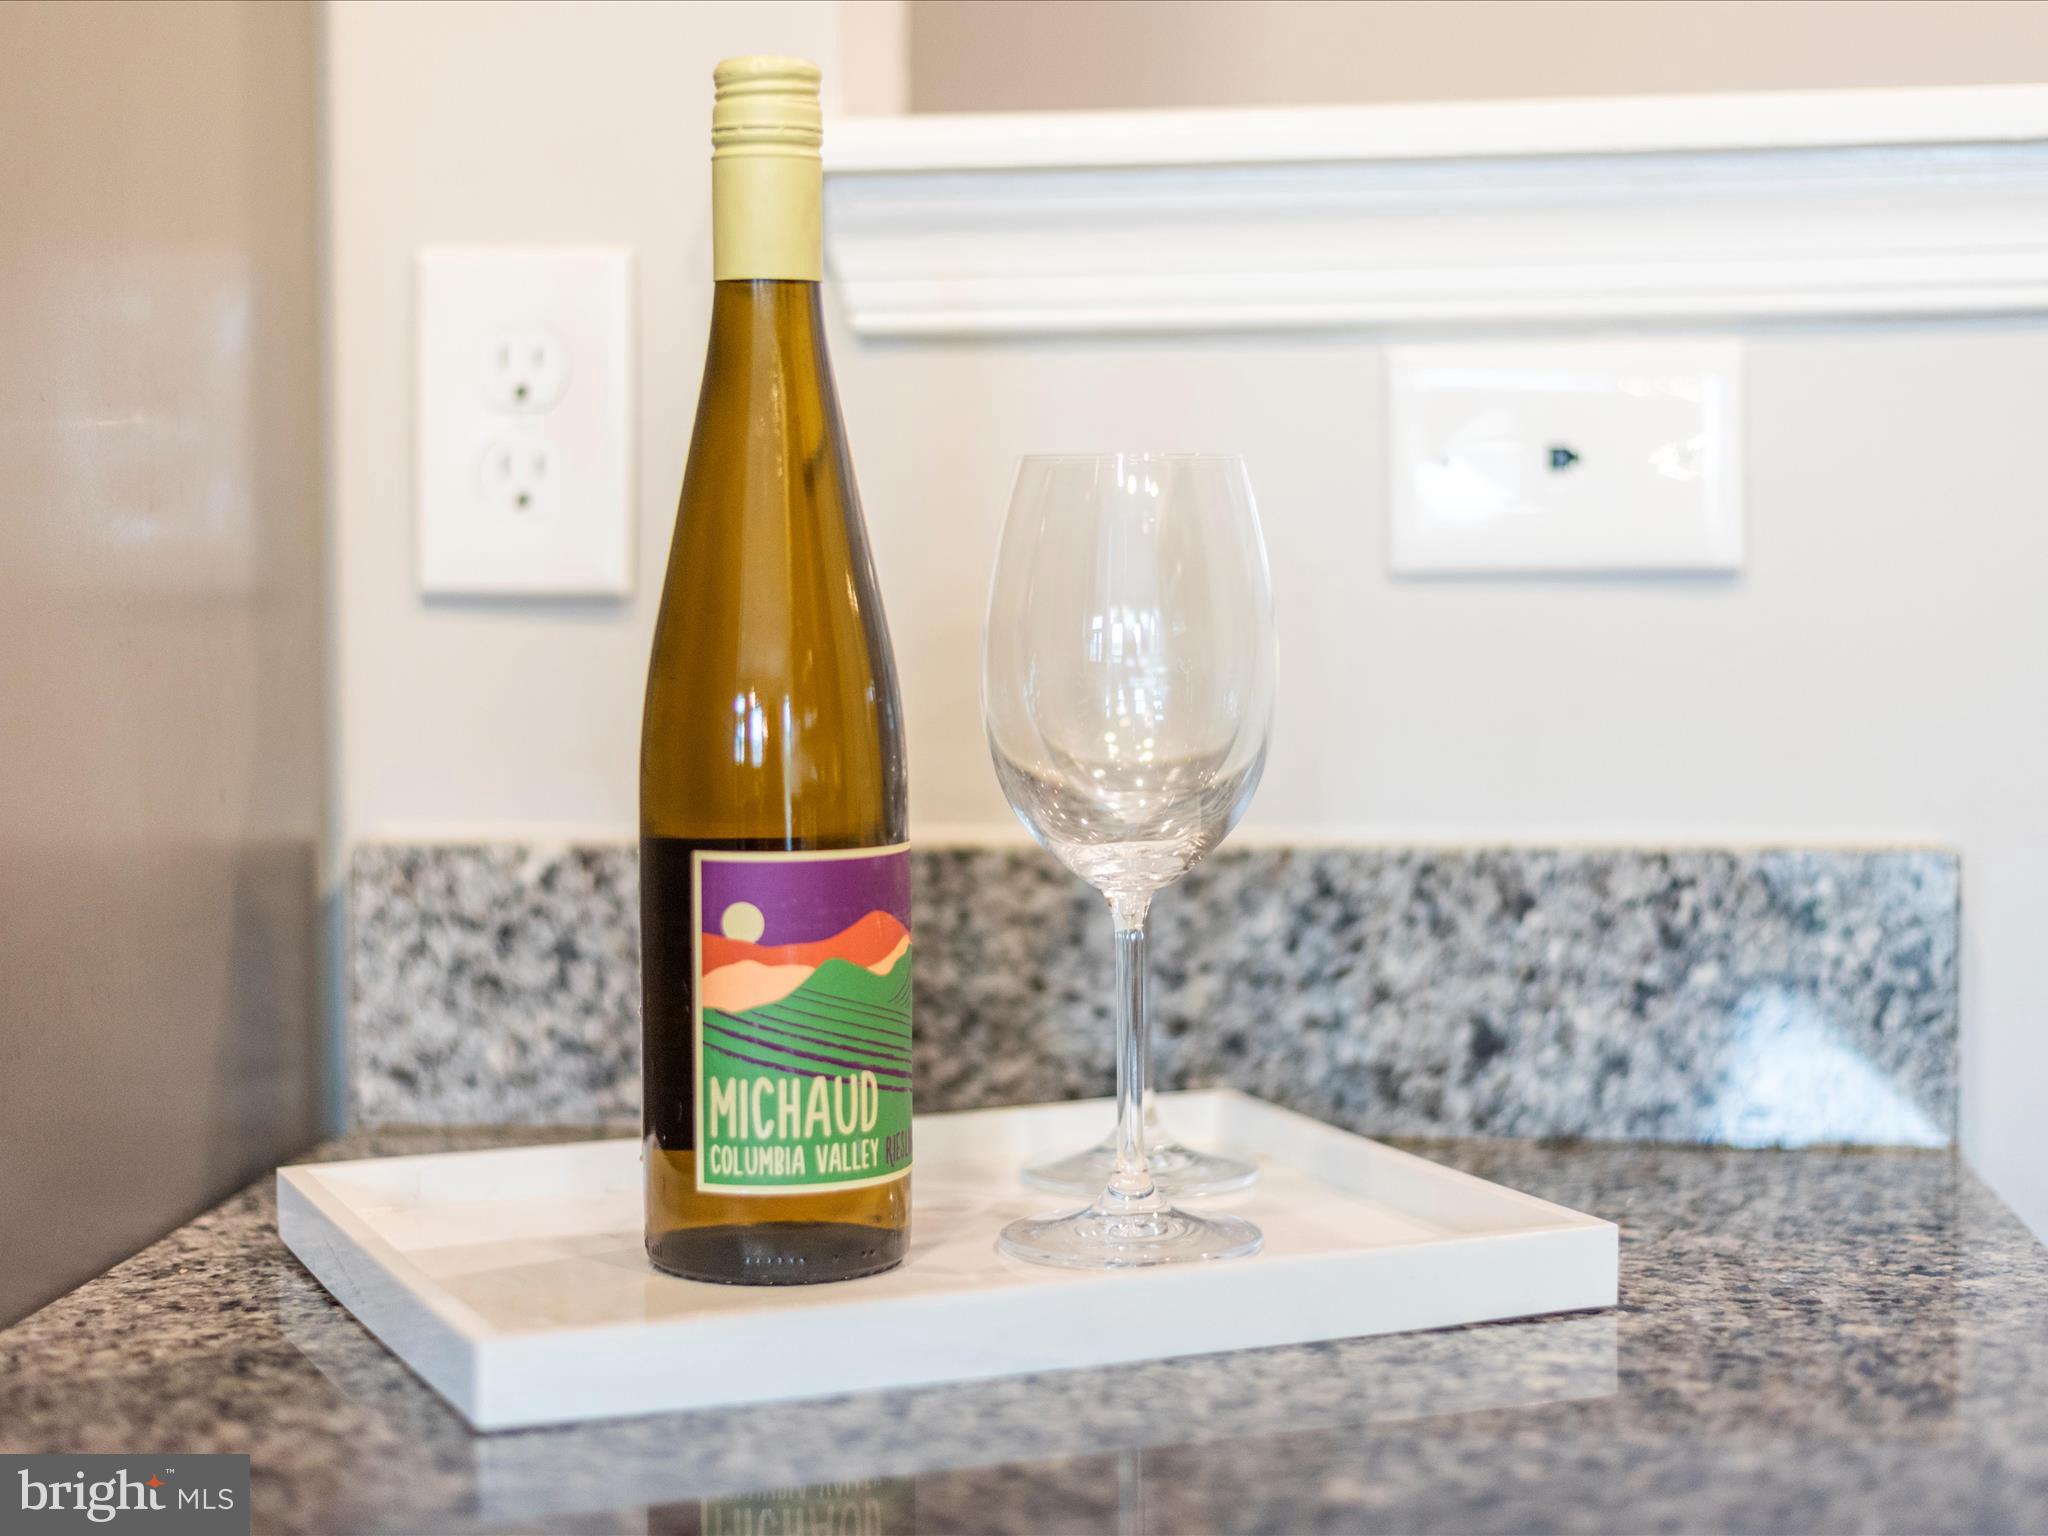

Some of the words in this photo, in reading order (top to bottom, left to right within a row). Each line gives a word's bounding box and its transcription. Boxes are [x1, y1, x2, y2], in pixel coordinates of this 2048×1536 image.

[710, 1070, 879, 1139] MICHAUD
[710, 1144, 805, 1175] COLUMBIA
[816, 1138, 879, 1174] VALLEY
